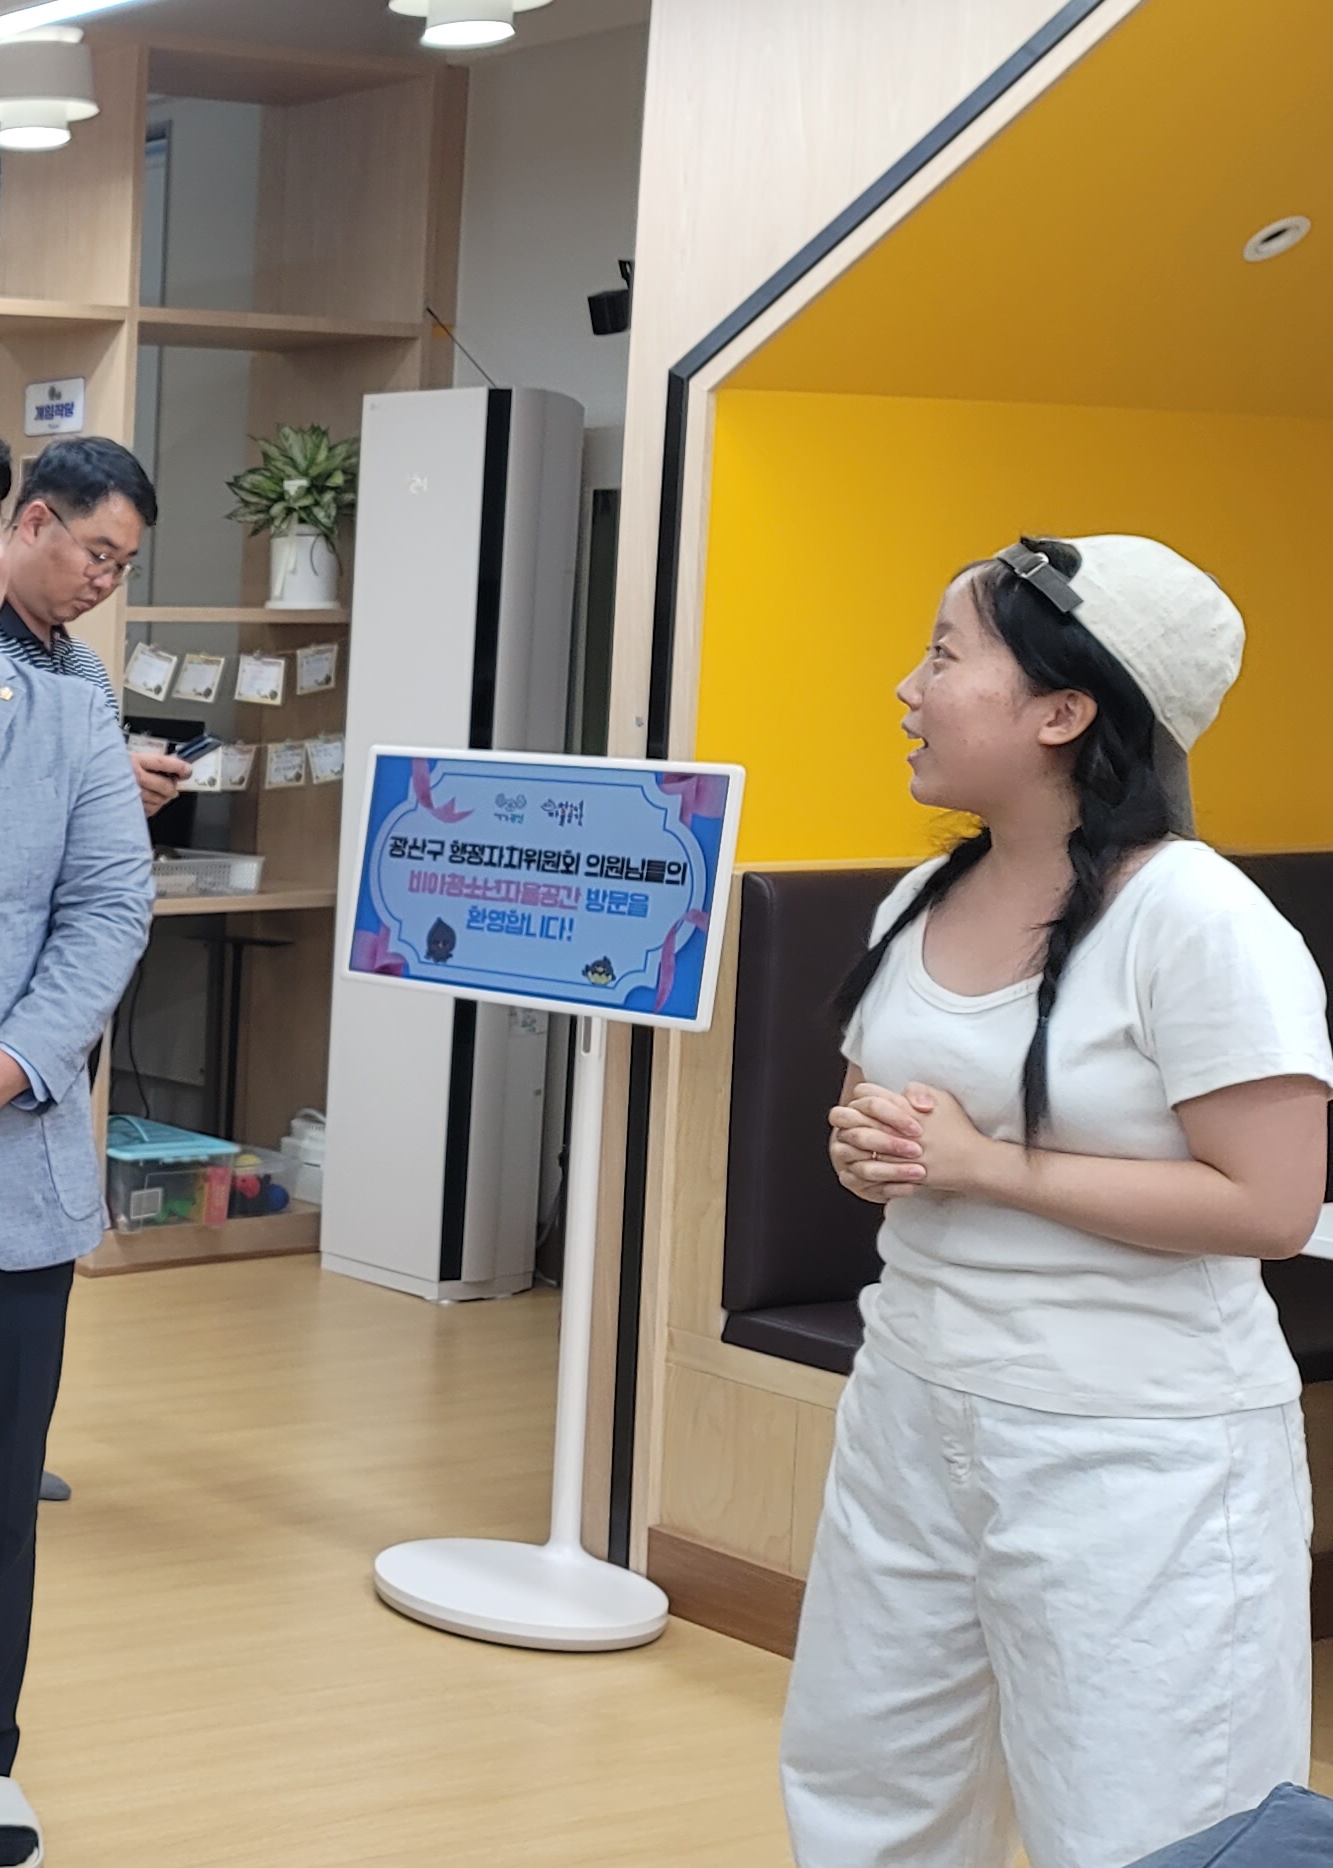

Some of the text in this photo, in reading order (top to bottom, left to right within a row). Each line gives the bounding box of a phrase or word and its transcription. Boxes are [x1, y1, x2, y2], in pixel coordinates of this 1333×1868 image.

[388, 835, 688, 886] 광산구 행정자치위원회 의원님들의
[586, 886, 650, 918] 방문을
[466, 905, 575, 942] 환영합니다!
